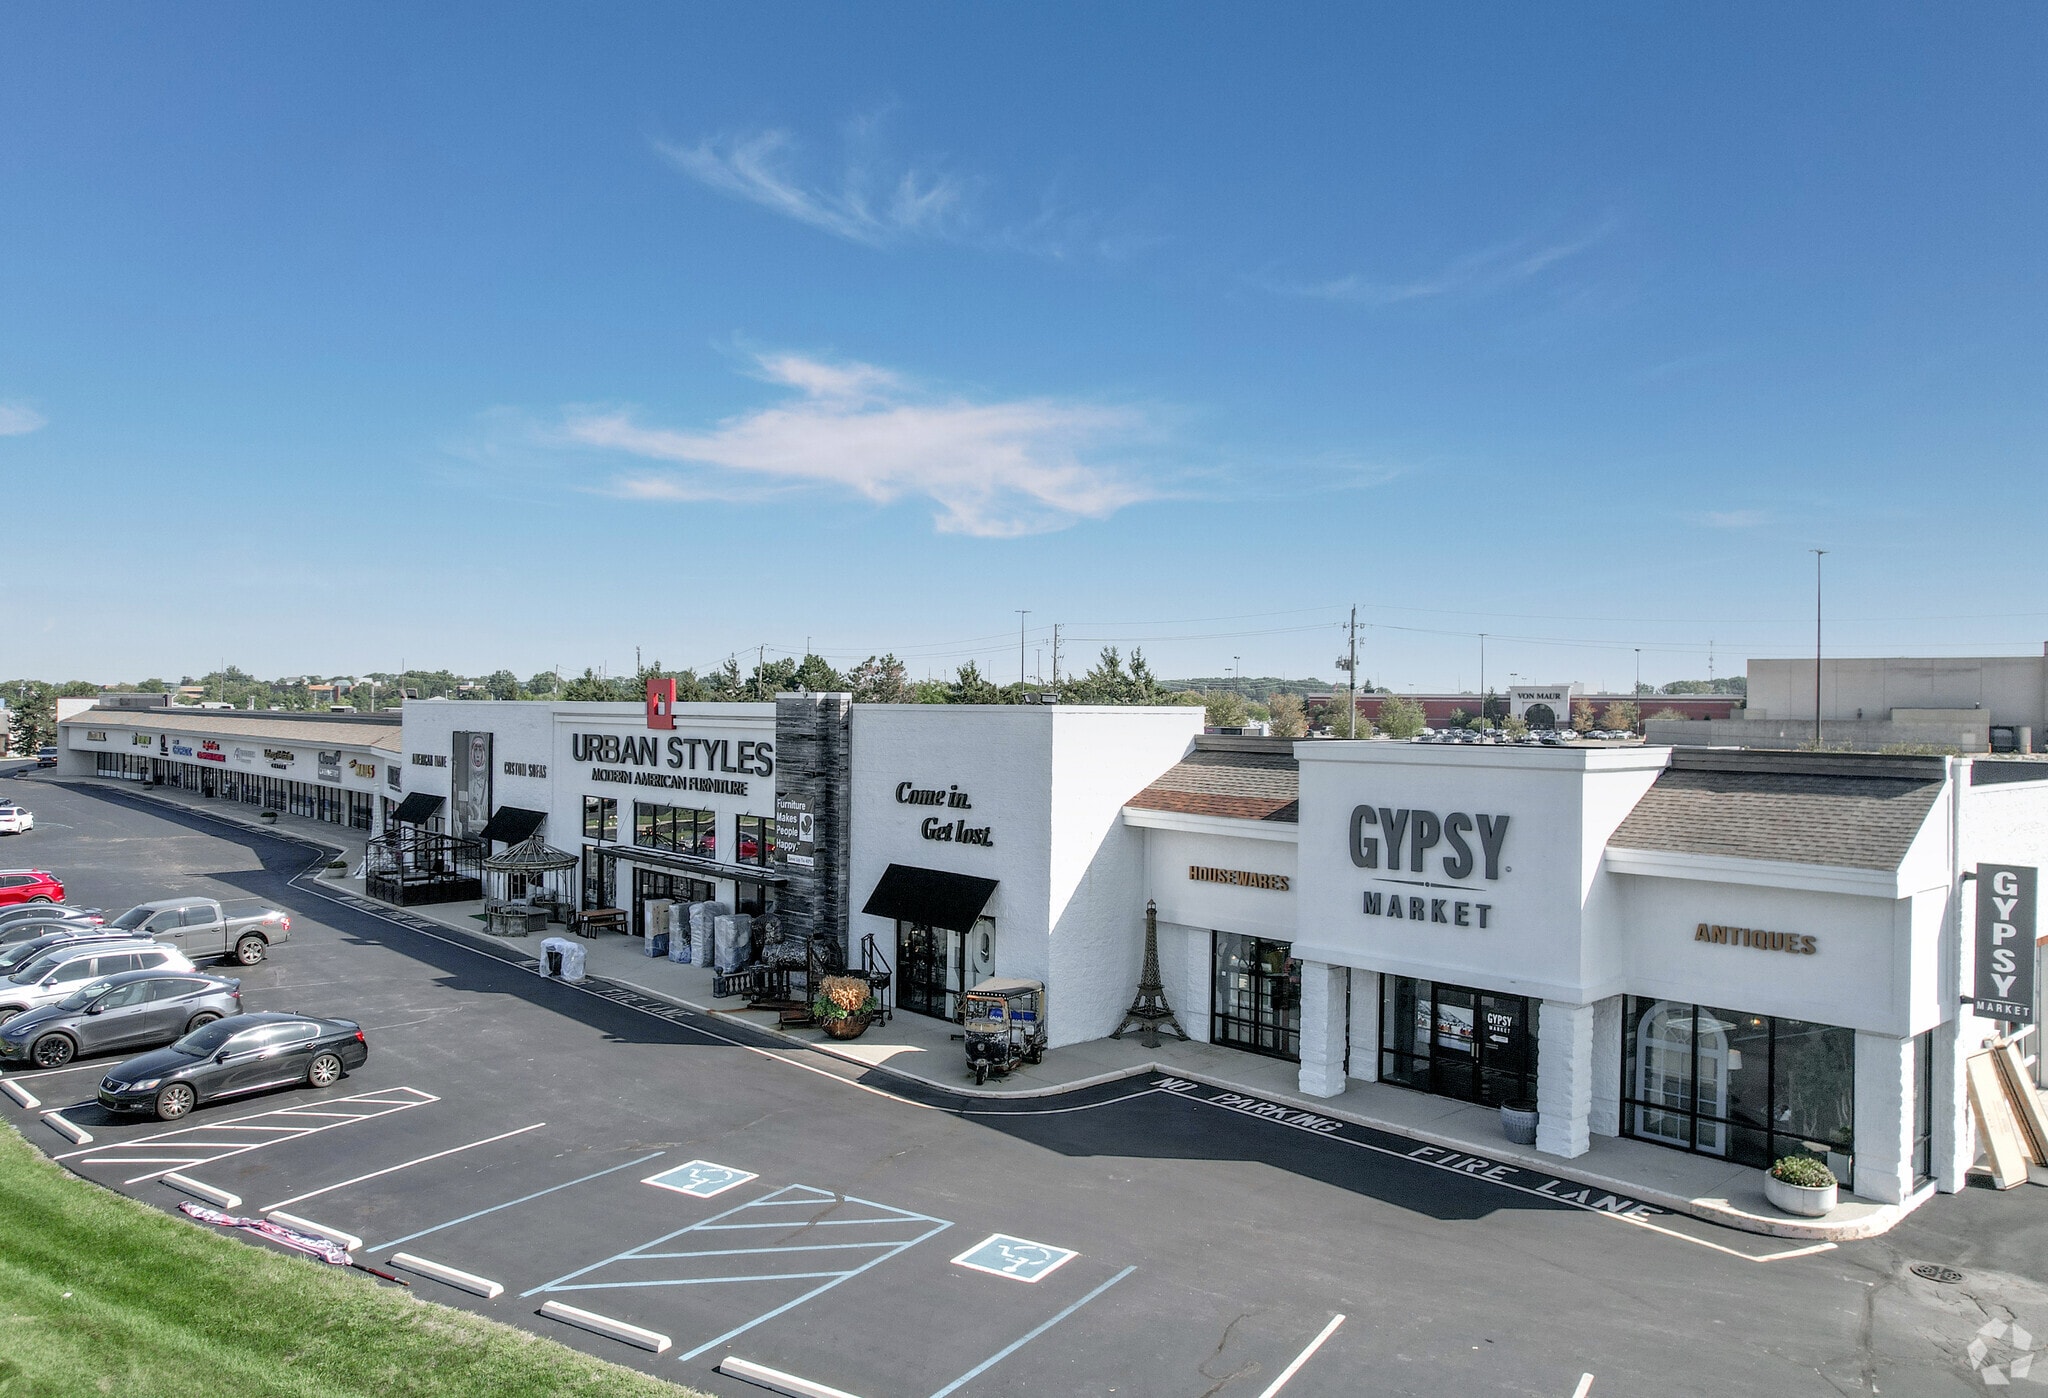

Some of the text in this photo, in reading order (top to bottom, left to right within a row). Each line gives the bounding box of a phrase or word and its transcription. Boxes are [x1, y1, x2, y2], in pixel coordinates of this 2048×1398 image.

[1517, 692, 1561, 700] VON MAUR
[504, 761, 547, 778] CUSTOM SOFAS
[572, 733, 774, 778] URBAN STYLES
[592, 767, 748, 797] MODERN AMERICAN FURNITURE
[895, 781, 972, 809] Come in.
[777, 799, 806, 810] Furniture
[777, 812, 797, 823] Makes
[776, 825, 798, 837] People
[921, 817, 994, 847] Get lost.
[1349, 804, 1511, 881] GYPSY
[1189, 865, 1290, 892] HOUSEWARES
[1363, 891, 1492, 929] MARKET
[1694, 923, 1817, 955] ANTIQUES
[1991, 871, 2019, 998] GYPSY
[1488, 1013, 1512, 1026] GYPSY
[1976, 1001, 2030, 1017] MARKET
[1150, 1077, 1664, 1222] NO PARKING FIRE LANE
